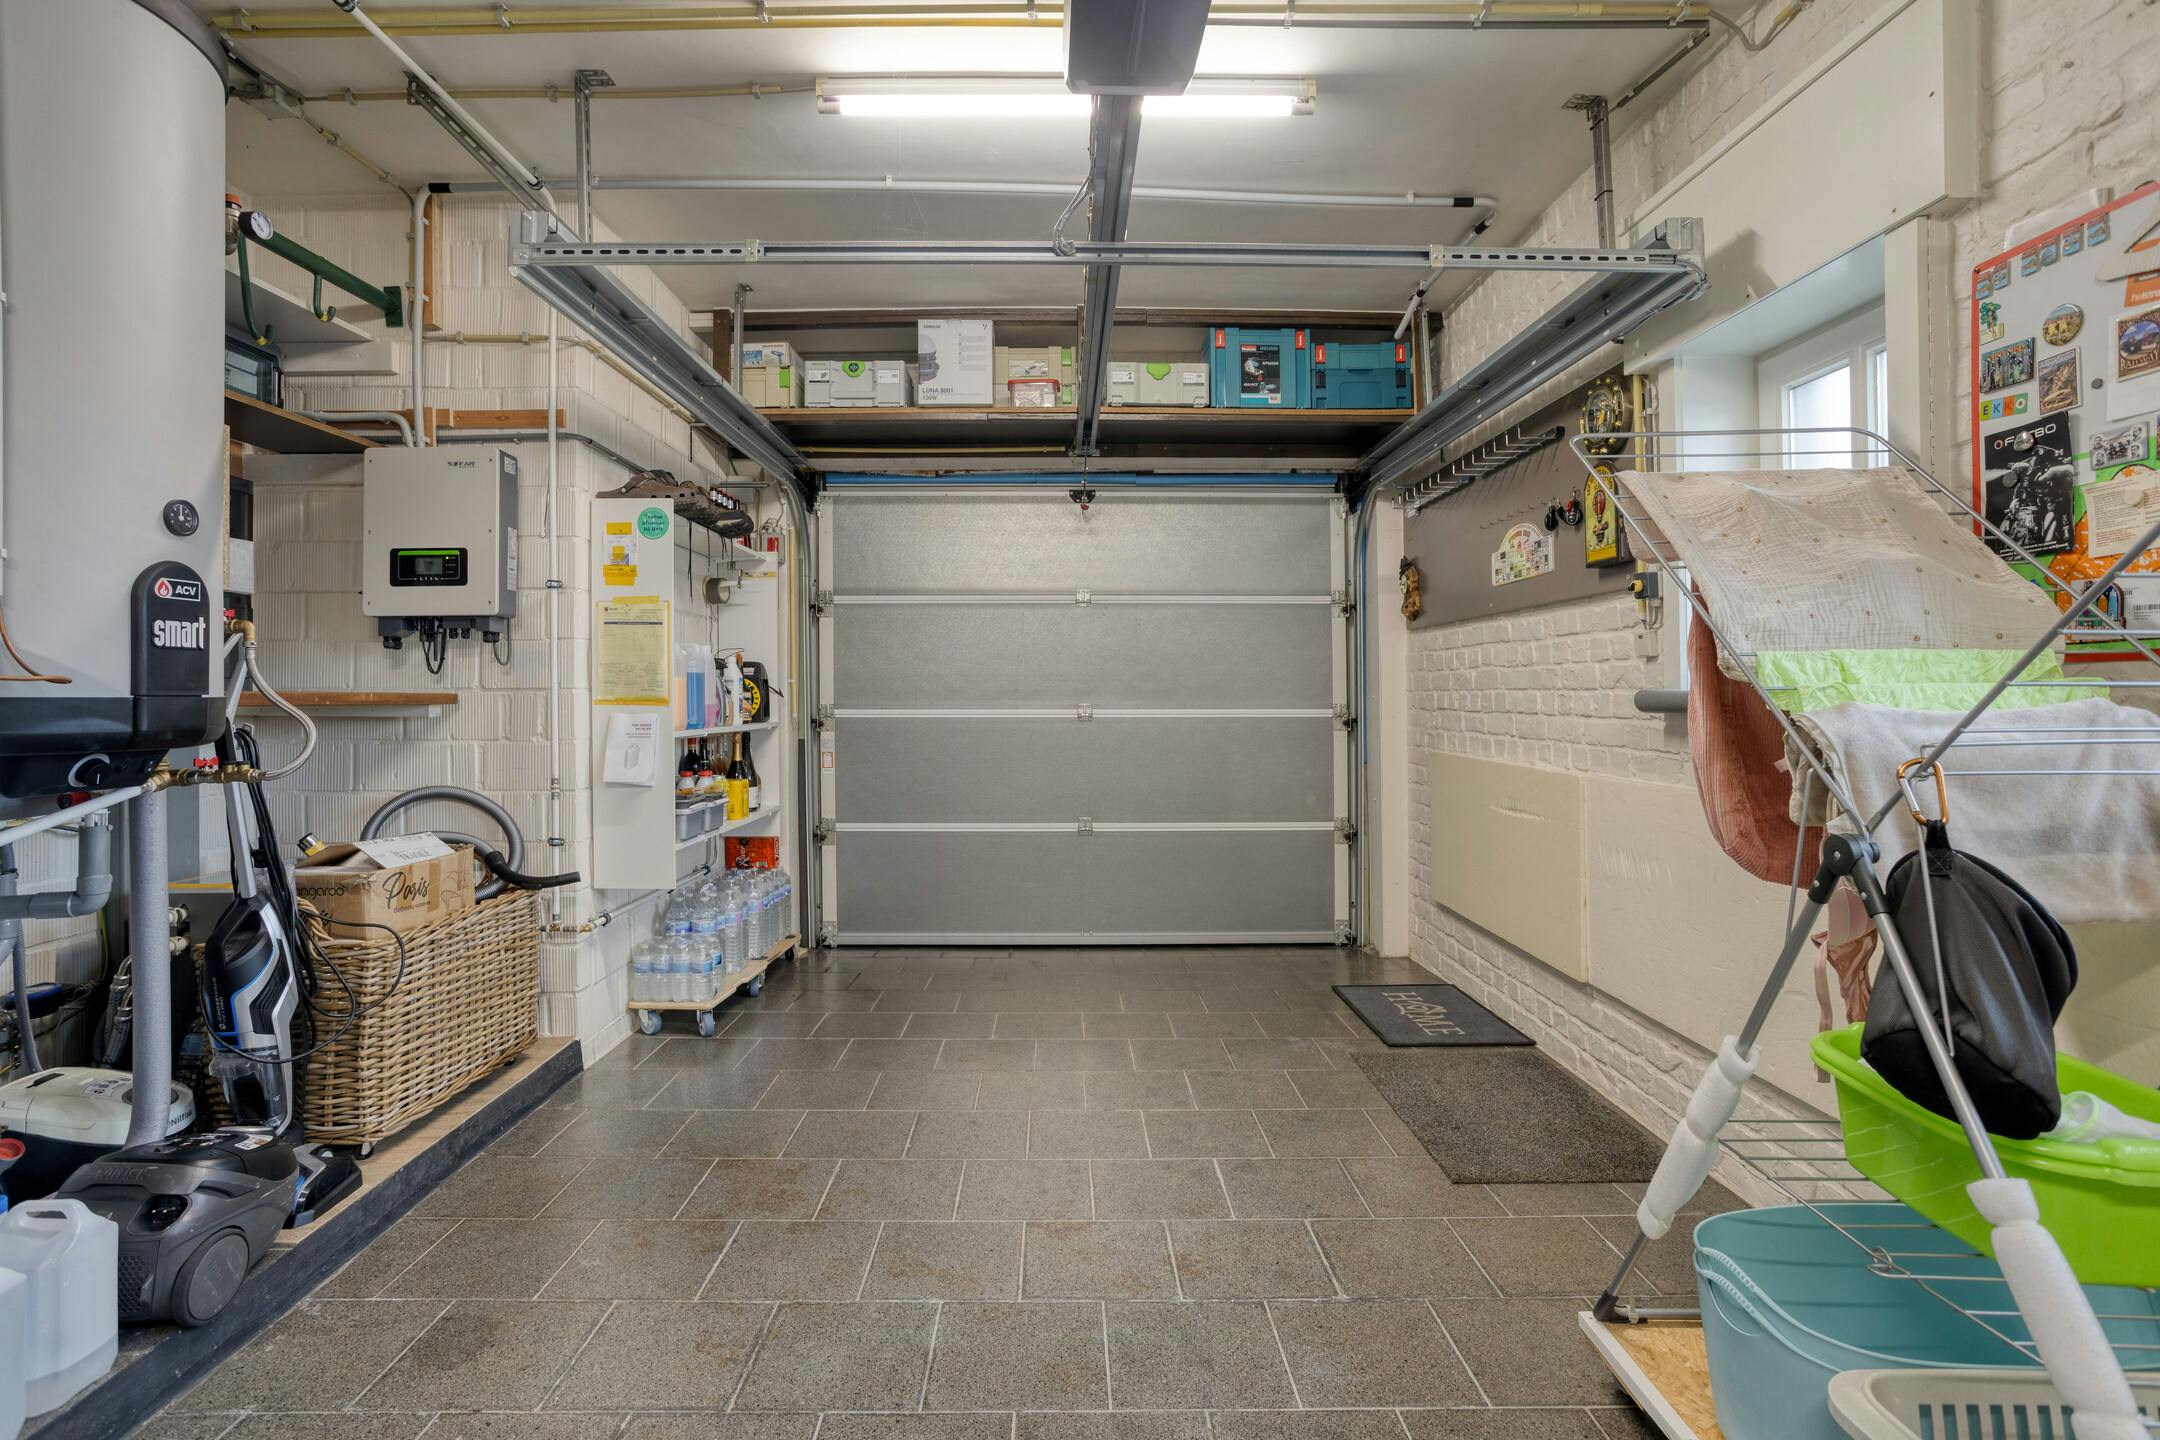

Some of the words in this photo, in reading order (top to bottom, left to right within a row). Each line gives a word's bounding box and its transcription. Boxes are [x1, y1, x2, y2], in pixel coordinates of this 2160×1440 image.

[2004, 423, 2057, 447] FBO
[175, 584, 196, 596] ACV
[153, 616, 206, 650] smart
[382, 871, 431, 909] Paris
[1382, 991, 1466, 1036] HOME
[170, 1110, 193, 1127] Nilfisk
